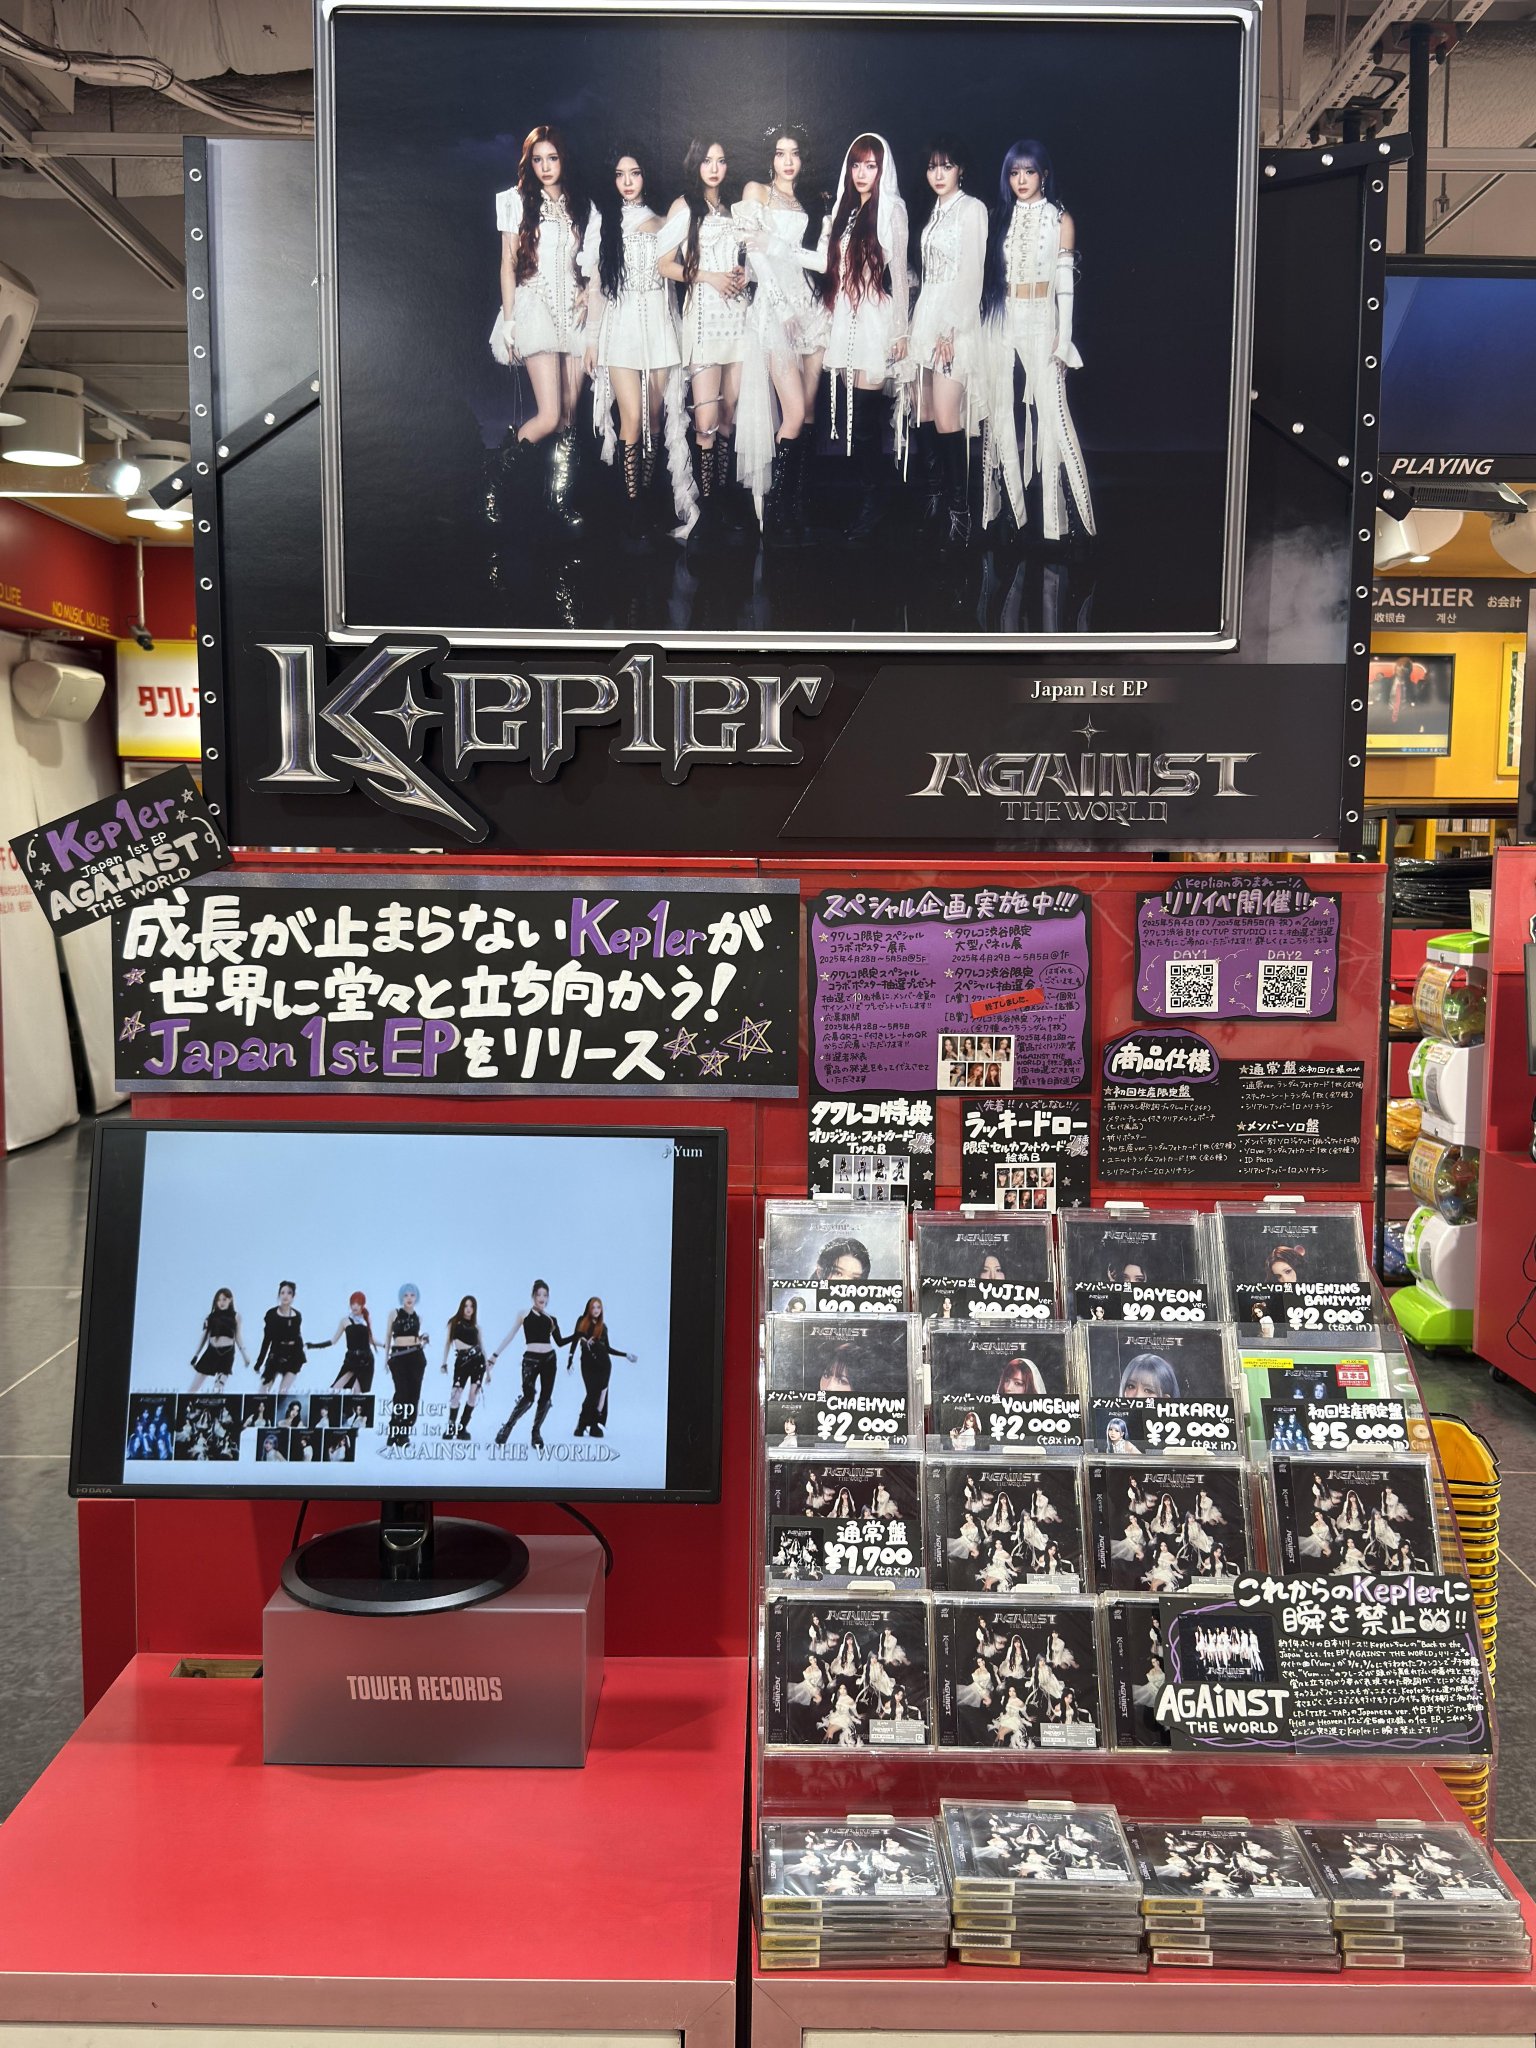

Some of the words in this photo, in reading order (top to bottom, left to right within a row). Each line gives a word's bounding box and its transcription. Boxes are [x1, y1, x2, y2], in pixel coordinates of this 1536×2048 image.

[1391, 458, 1494, 475] PLAYING
[1487, 596, 1522, 608] お会計
[1436, 613, 1457, 624] 계산
[1031, 680, 1085, 702] Japan
[1091, 680, 1115, 697] 1st
[1122, 680, 1148, 697] EP
[905, 752, 1262, 797] AGAINST
[1001, 801, 1061, 824] THE
[1060, 801, 1168, 827] WORLD
[46, 798, 175, 873] Kep1er
[80, 854, 123, 878] Japan
[127, 843, 148, 858] 1st
[151, 831, 167, 847] EP
[50, 832, 199, 921] AGAINST
[87, 894, 126, 919] THE
[131, 867, 191, 900] WORLD
[823, 889, 1079, 921] スペシャル企画実施中!!!
[1166, 888, 1311, 916] リリイベ開催!!
[1173, 949, 1207, 960] DAY1
[1268, 949, 1303, 960] DAY2
[1111, 1042, 1211, 1073] 商品仕様
[1249, 1061, 1297, 1075] 通常盤
[811, 1098, 933, 1127] タワレコ特典
[965, 1109, 1088, 1138] ラッキードロー
[1247, 1118, 1319, 1133] メンバーソロ盤
[674, 1145, 703, 1157] Yum
[772, 1280, 829, 1290] メンバーソロ盤
[830, 1284, 903, 1298] XIAOTING
[922, 1277, 977, 1288] メンバーソロ盤
[1074, 1282, 1133, 1293] メンバーソロ盤
[1236, 1282, 1293, 1293] メンバーソロ盤
[1295, 1283, 1360, 1296] HUENING
[1133, 1287, 1203, 1303] DAYEON
[767, 1391, 827, 1402] メンバーソロ盤
[826, 1395, 905, 1413] CHAEHYUN
[1093, 1397, 1156, 1409] メンバーソロ盤
[1001, 1397, 1080, 1414] YOUNGEUN
[1157, 1402, 1229, 1418] HIKARU
[1308, 1402, 1404, 1420] 初回生産限定盤
[376, 1424, 416, 1436] Japan
[445, 1424, 464, 1436] EP
[487, 1443, 528, 1461] THE
[837, 1520, 908, 1545] 通常盤
[824, 1541, 913, 1576] ¥1,700
[346, 1675, 412, 1701] TOWER
[417, 1676, 503, 1701] RECORDS
[1185, 1721, 1219, 1735] THE
[1223, 1721, 1278, 1735] WORLD
